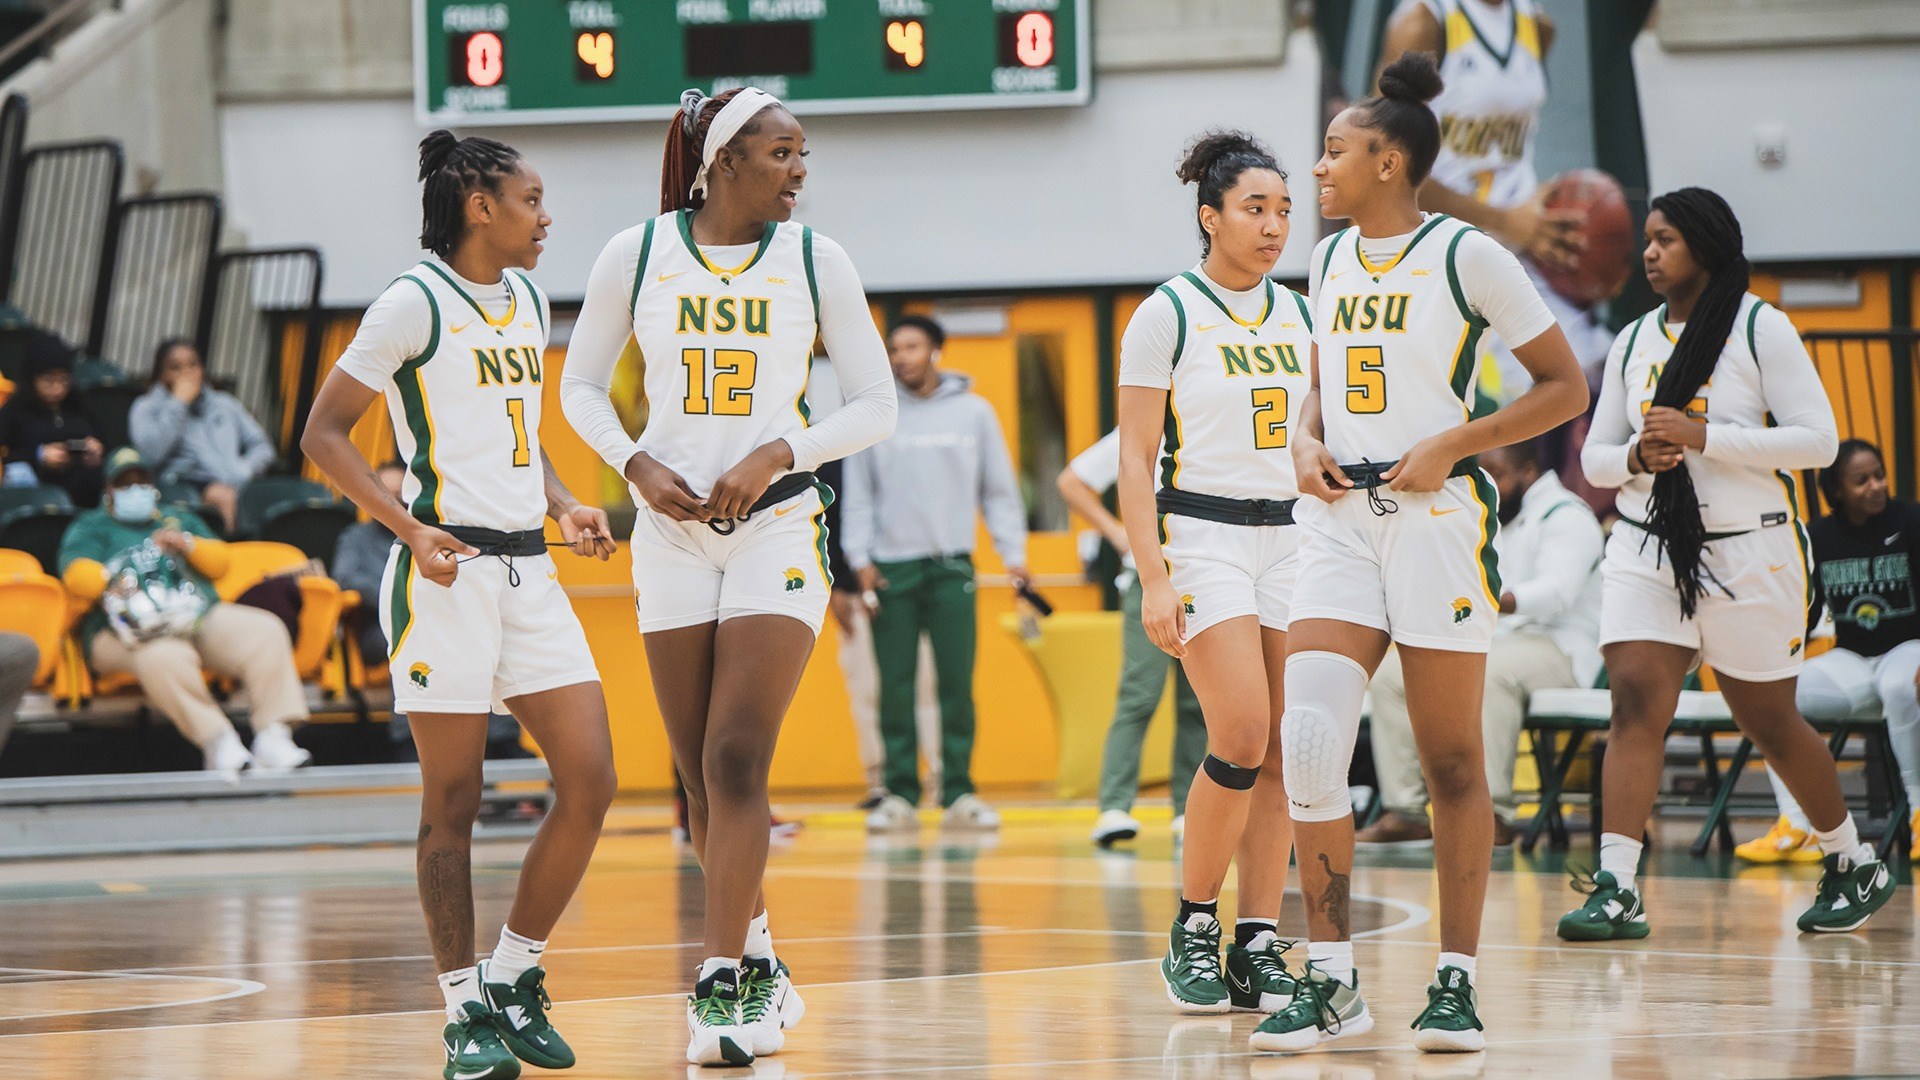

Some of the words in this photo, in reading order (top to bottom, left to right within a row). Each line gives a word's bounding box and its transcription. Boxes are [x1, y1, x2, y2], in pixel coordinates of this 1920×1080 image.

[466, 32, 502, 87] 0
[577, 32, 614, 79] 4
[886, 21, 924, 68] 4
[1016, 11, 1054, 68] 0
[675, 295, 771, 337] NSU
[1330, 293, 1413, 335] NSU
[472, 347, 542, 387] NSU
[682, 348, 758, 416] 12
[1217, 343, 1304, 378] NSU
[1345, 345, 1387, 414] 5
[506, 397, 530, 468] 1
[1251, 386, 1288, 450] 2
